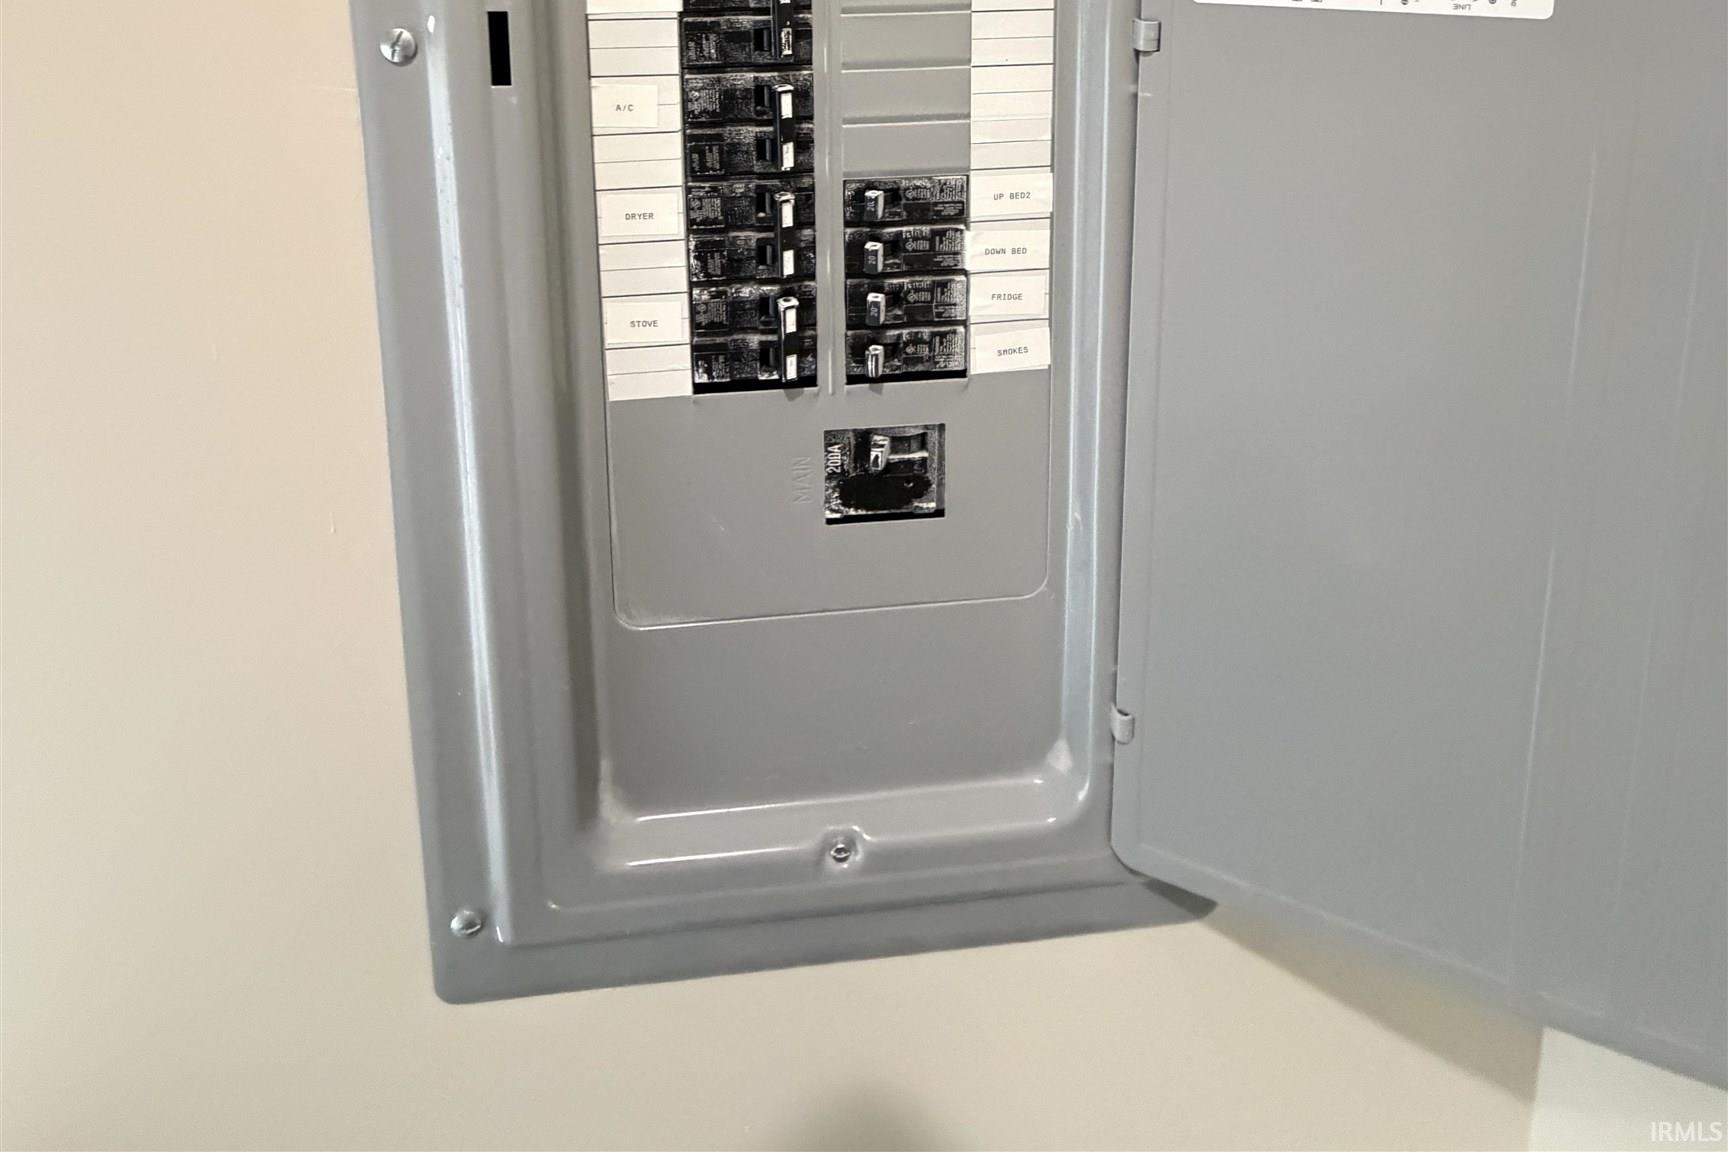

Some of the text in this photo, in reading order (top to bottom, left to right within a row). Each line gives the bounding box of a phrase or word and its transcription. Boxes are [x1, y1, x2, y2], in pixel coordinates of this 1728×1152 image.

[615, 103, 634, 112] A/C
[993, 191, 1031, 201] UP BED2
[624, 212, 655, 221] DRYER
[984, 247, 1028, 256] DOWN BED
[991, 292, 1023, 301] FRIDGE
[629, 319, 659, 328] STOVE
[996, 346, 1029, 357] SMOKES
[826, 444, 843, 473] 200A
[791, 456, 813, 505] MAIN
